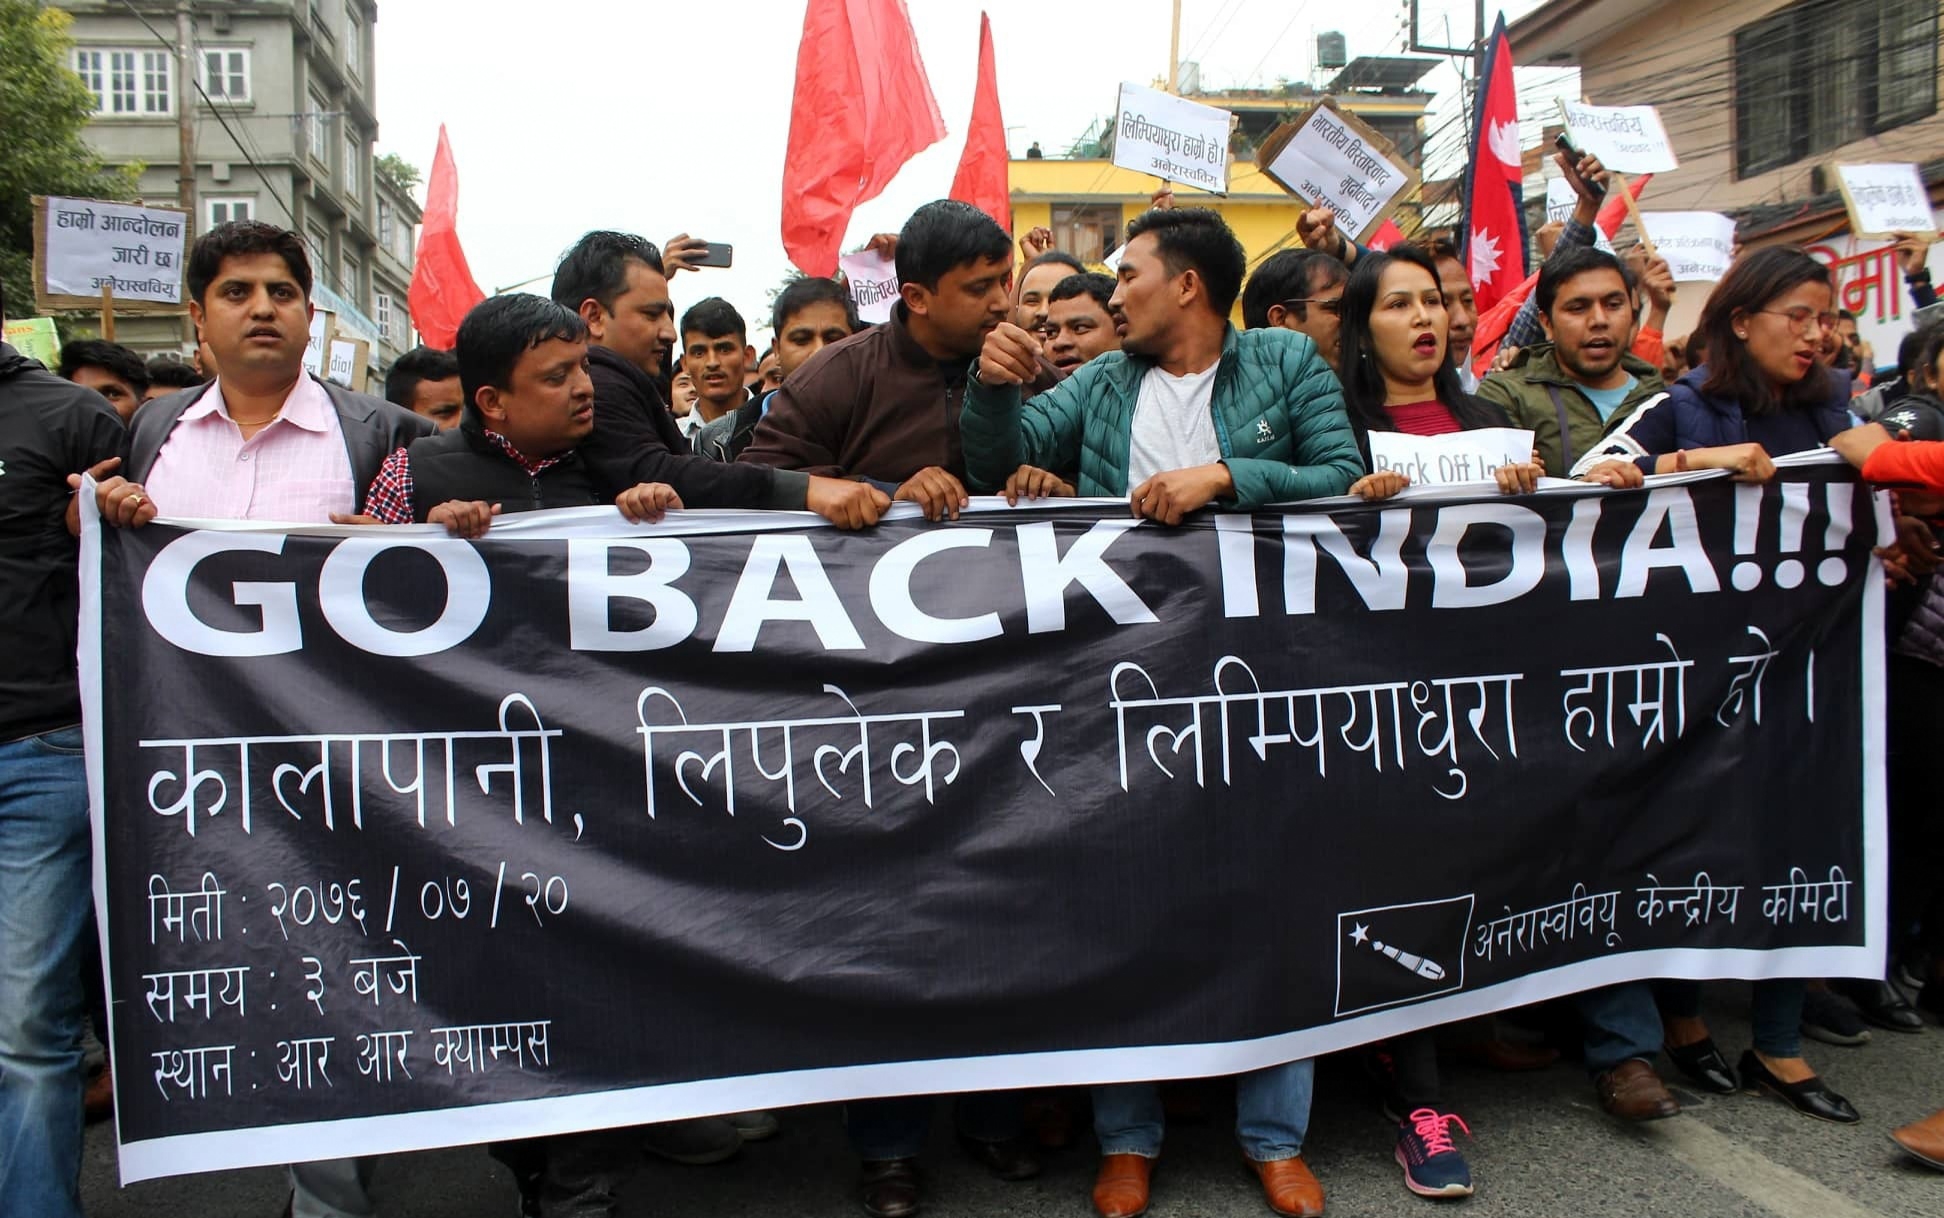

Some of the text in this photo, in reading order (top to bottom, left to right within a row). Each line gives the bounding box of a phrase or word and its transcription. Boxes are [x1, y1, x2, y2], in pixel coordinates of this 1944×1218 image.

[1183, 133, 1206, 160] हाम्रो
[1311, 114, 1350, 150] भारतीय
[56, 208, 180, 239] हाम्रो आन्दोलन
[112, 244, 150, 265] जारी
[1438, 454, 1471, 483] Off
[141, 481, 1855, 657] GO BACK INDIA!!!
[138, 692, 586, 842] कालापानी,
[636, 682, 966, 852] लिपुलेक
[1011, 703, 1062, 797] र
[1109, 655, 1524, 800] लिम्पियाधुरा
[1560, 632, 1695, 752] हाम्रो
[148, 871, 227, 945] मिती
[1473, 865, 1853, 962] अनेरास्ववियू केन्द्रीय कमिटी
[142, 966, 251, 1024] समय
[302, 956, 326, 1016] ३
[349, 939, 423, 1006] बजे
[151, 1044, 236, 1101] स्थान
[276, 1036, 336, 1090] आर
[356, 1030, 414, 1082] आर
[430, 1020, 552, 1075] क्याम्पस
